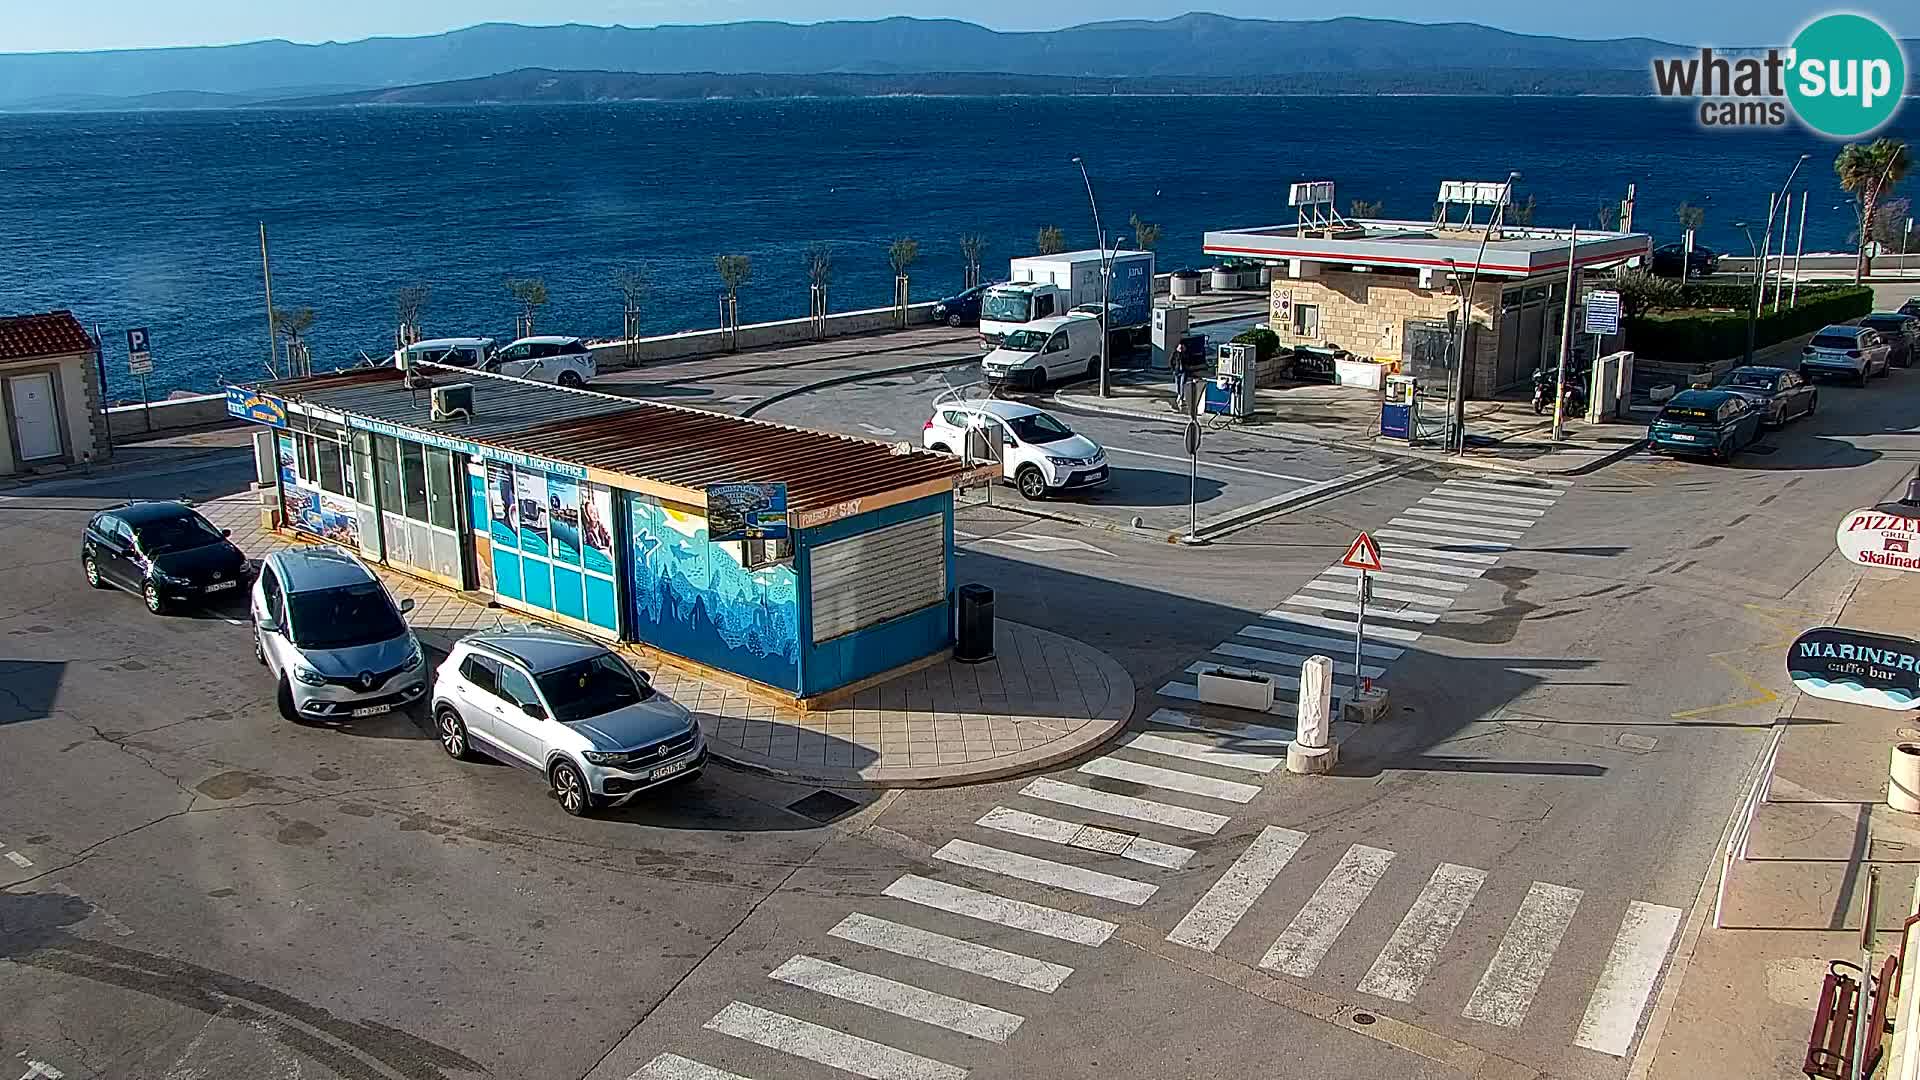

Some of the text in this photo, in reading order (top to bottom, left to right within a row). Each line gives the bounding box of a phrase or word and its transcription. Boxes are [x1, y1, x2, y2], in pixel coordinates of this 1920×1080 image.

[131, 331, 144, 350] P
[397, 428, 436, 443] AUTOBUSNA
[437, 437, 468, 451] POSTAJA
[495, 450, 526, 464] STATION
[529, 456, 555, 470] TICKET
[556, 463, 583, 477] OFFICE
[1881, 531, 1916, 541] GRILL
[1827, 661, 1896, 681] caffe bar
